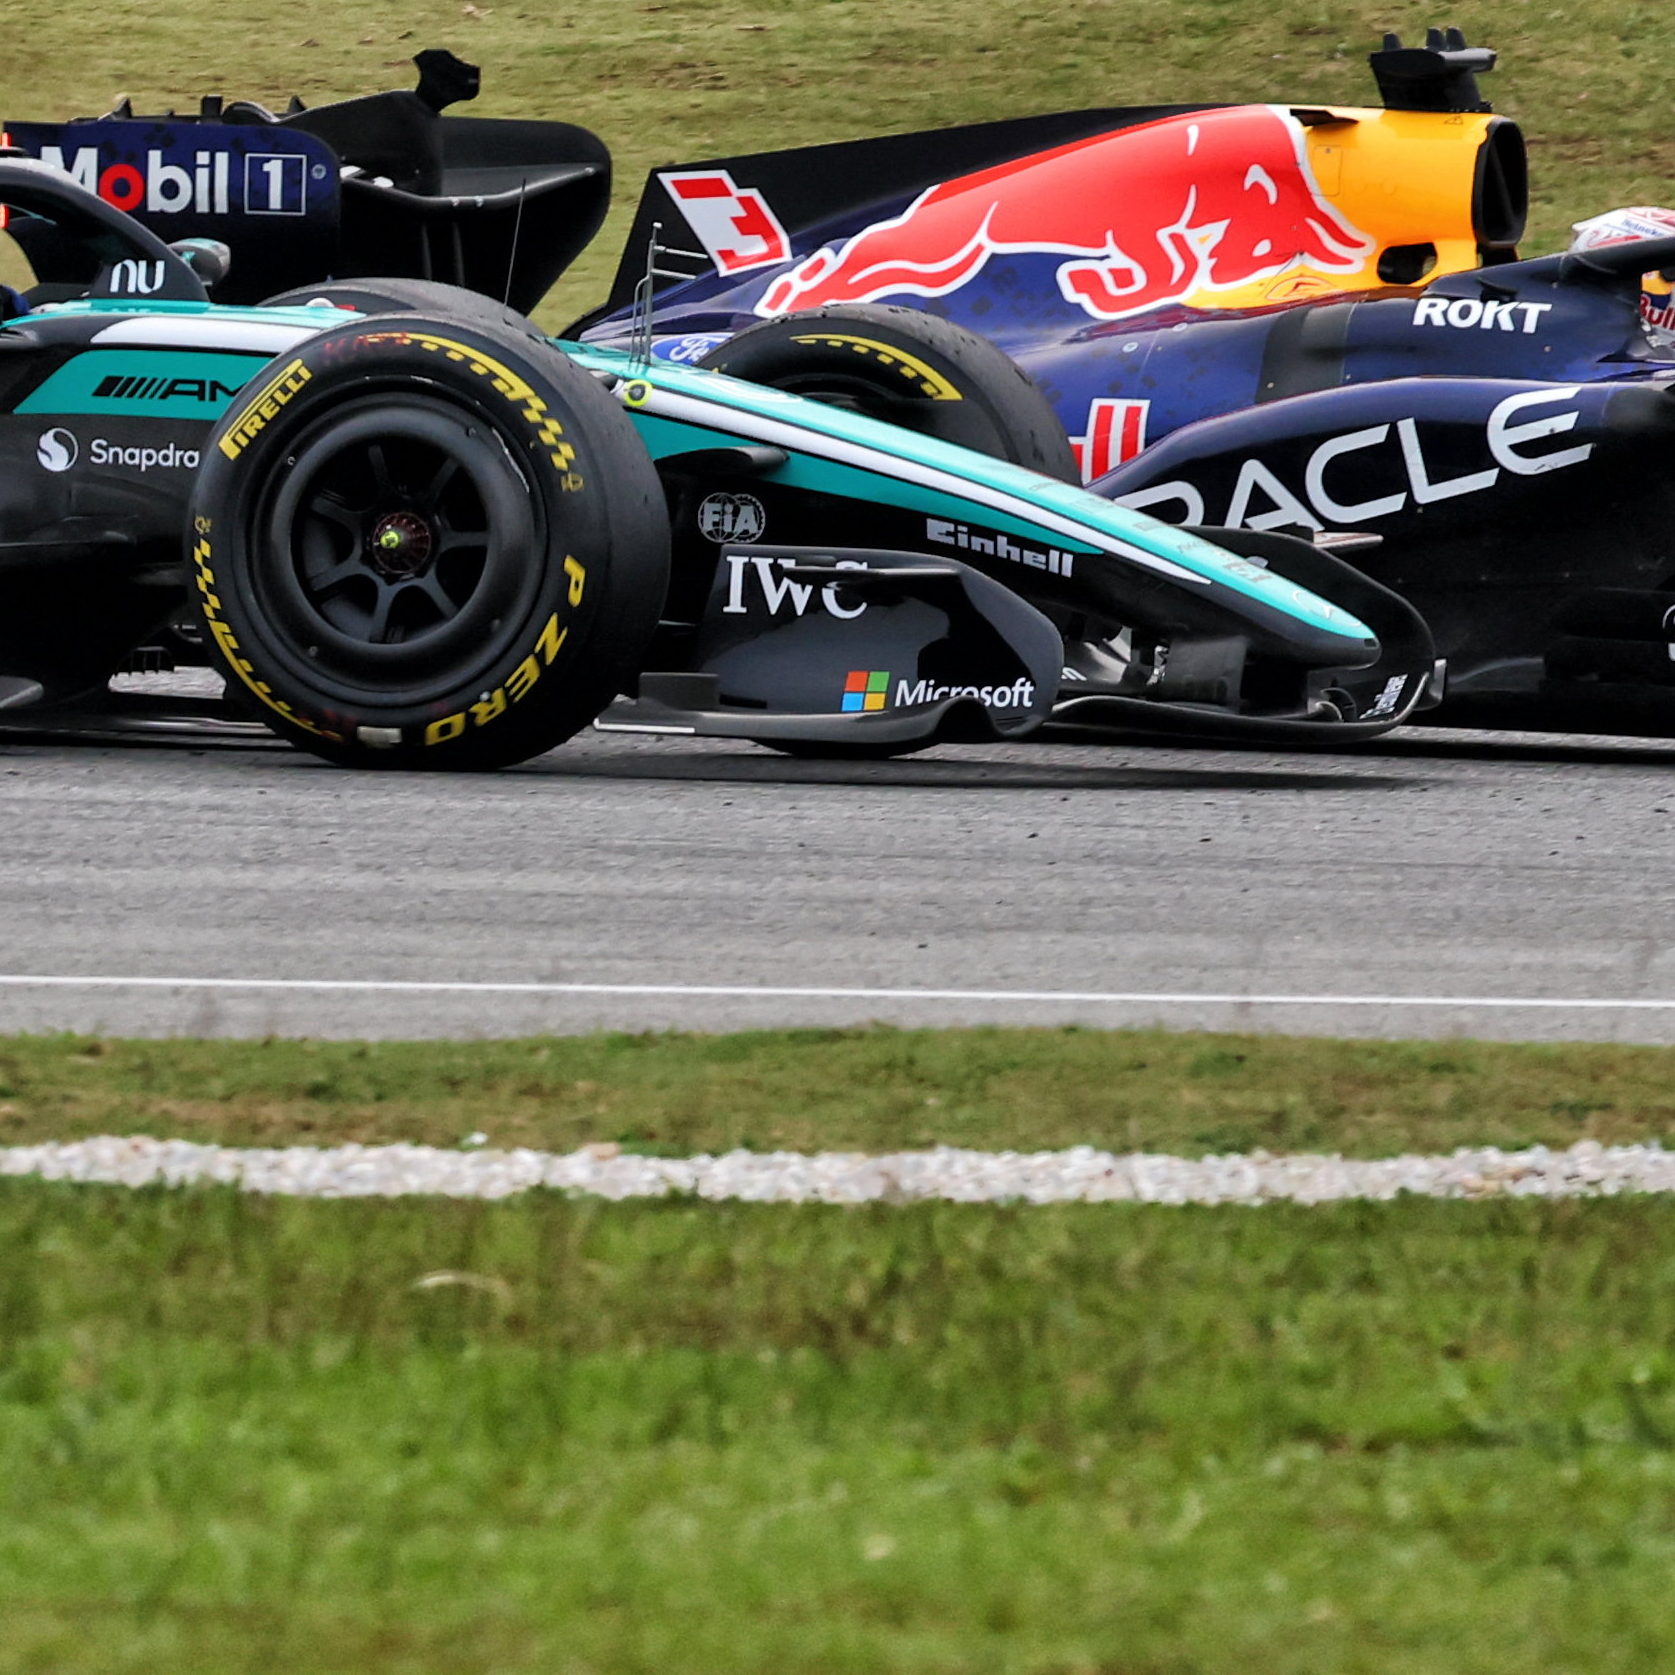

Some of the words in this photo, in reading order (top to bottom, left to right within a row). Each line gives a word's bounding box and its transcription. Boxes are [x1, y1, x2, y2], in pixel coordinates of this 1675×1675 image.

[40, 146, 230, 214] Mobil
[1412, 298, 1553, 334] ROKT
[218, 358, 314, 461] PIRELLI
[926, 517, 1074, 579] Einhell
[563, 555, 587, 608] P
[722, 554, 869, 620] IWC
[426, 612, 568, 745] ZERO
